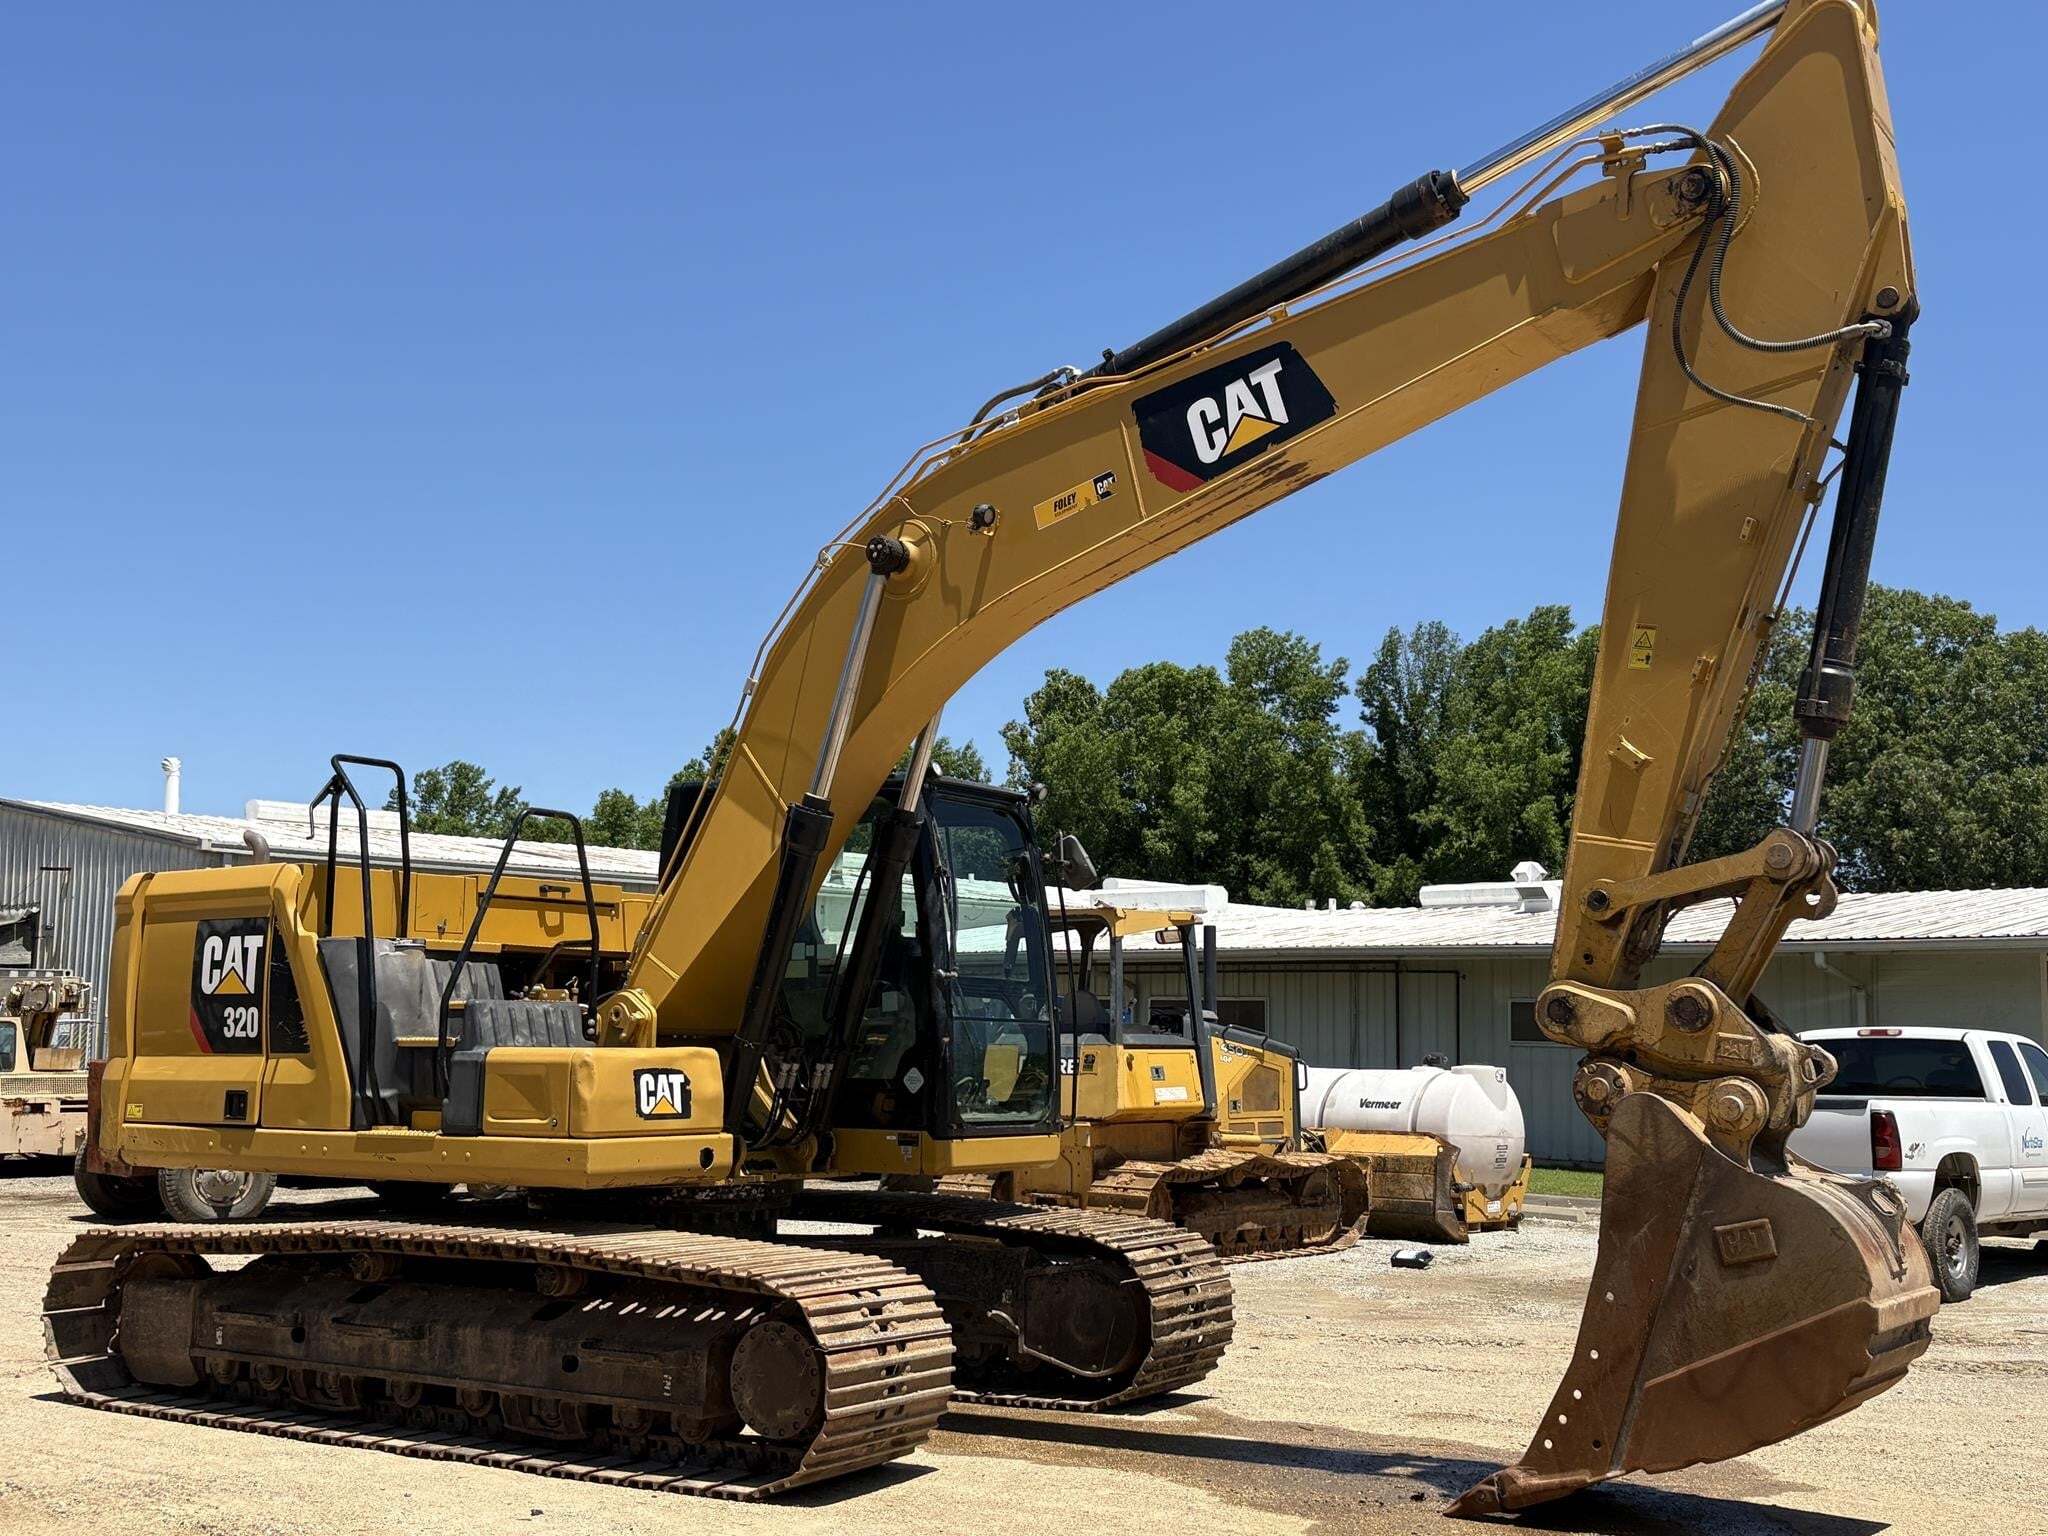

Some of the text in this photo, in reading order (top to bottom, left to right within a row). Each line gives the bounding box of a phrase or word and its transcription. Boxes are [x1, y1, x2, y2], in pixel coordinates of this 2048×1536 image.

[1187, 358, 1289, 464] CAT
[1053, 492, 1077, 513] FOLEY
[202, 935, 264, 995] CAT
[223, 1006, 259, 1038] 320
[640, 1073, 685, 1115] CAT
[1359, 1097, 1402, 1110] Vermeer
